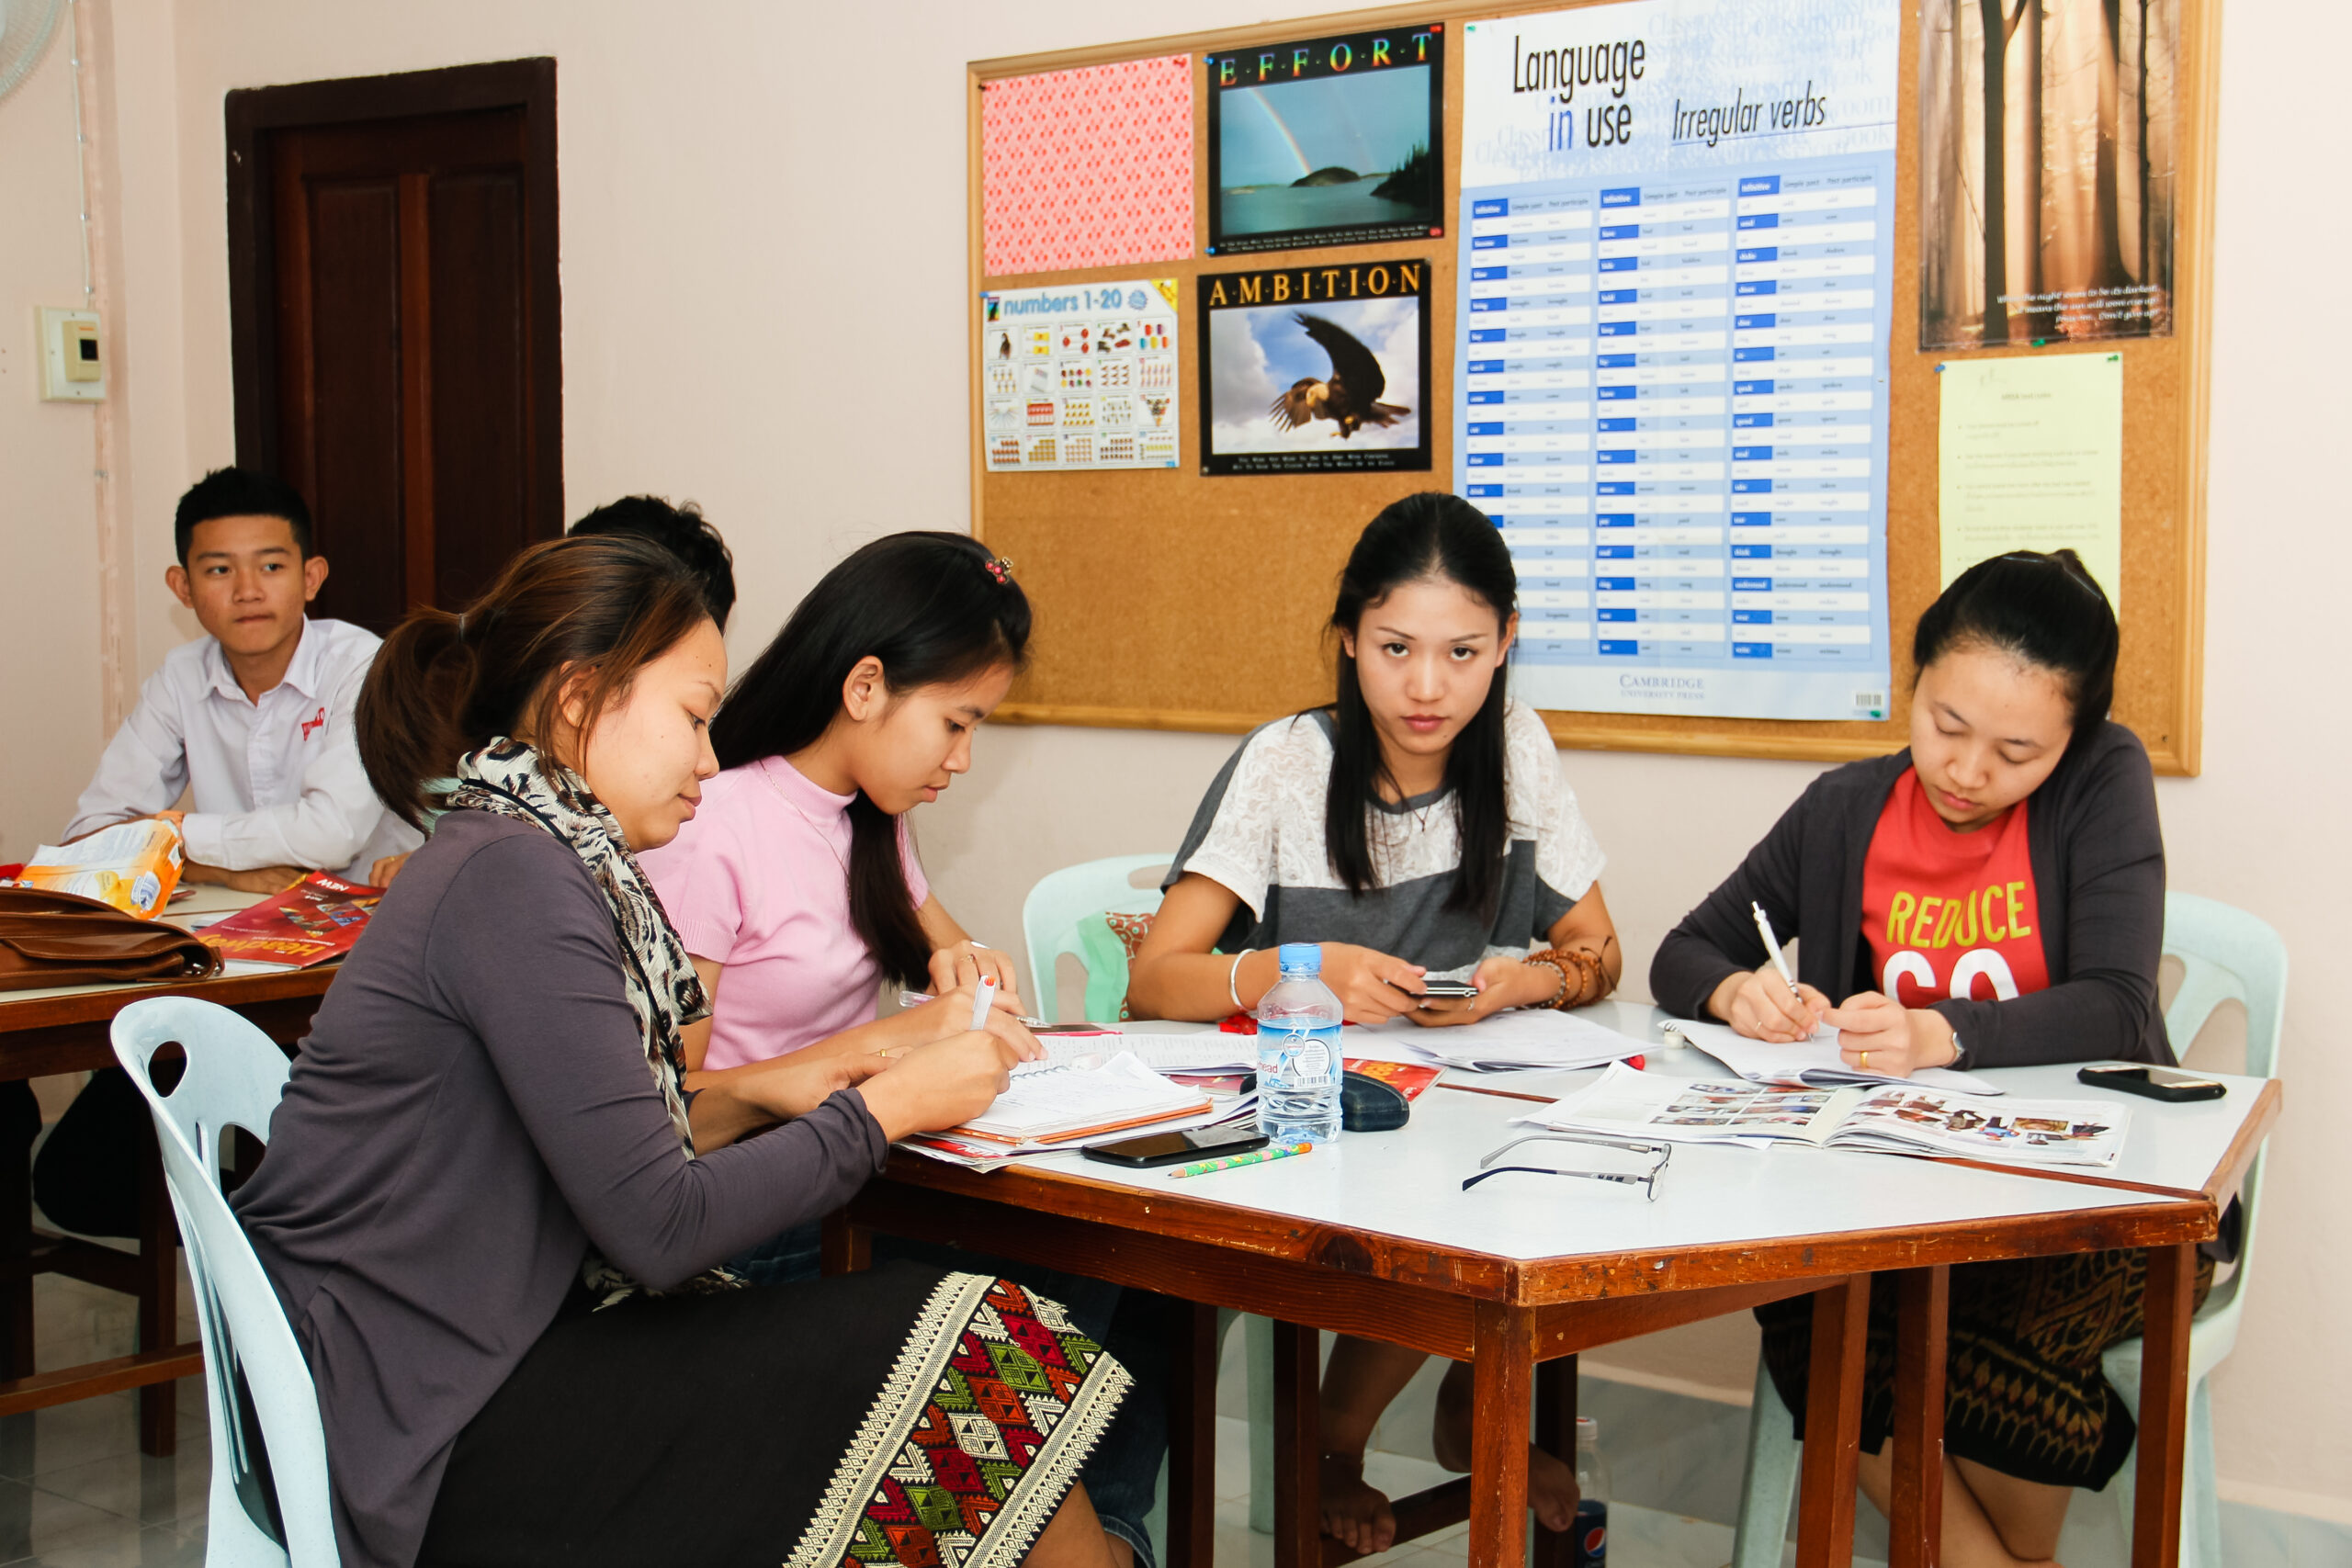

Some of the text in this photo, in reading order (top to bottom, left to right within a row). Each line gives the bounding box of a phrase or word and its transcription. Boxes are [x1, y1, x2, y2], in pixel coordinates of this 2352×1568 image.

[1512, 35, 1645, 104] Language
[1549, 96, 1573, 152] in
[1587, 105, 1633, 148] use
[1672, 87, 1763, 148] Irregular
[1770, 79, 1826, 129] verbs
[1003, 292, 1079, 316] numbers
[1084, 288, 1123, 310] 1-20
[1619, 673, 1703, 689] CAMBRIDGE
[316, 878, 350, 892] NEW
[1886, 881, 2031, 949] REDUCE
[198, 933, 326, 957] Headway
